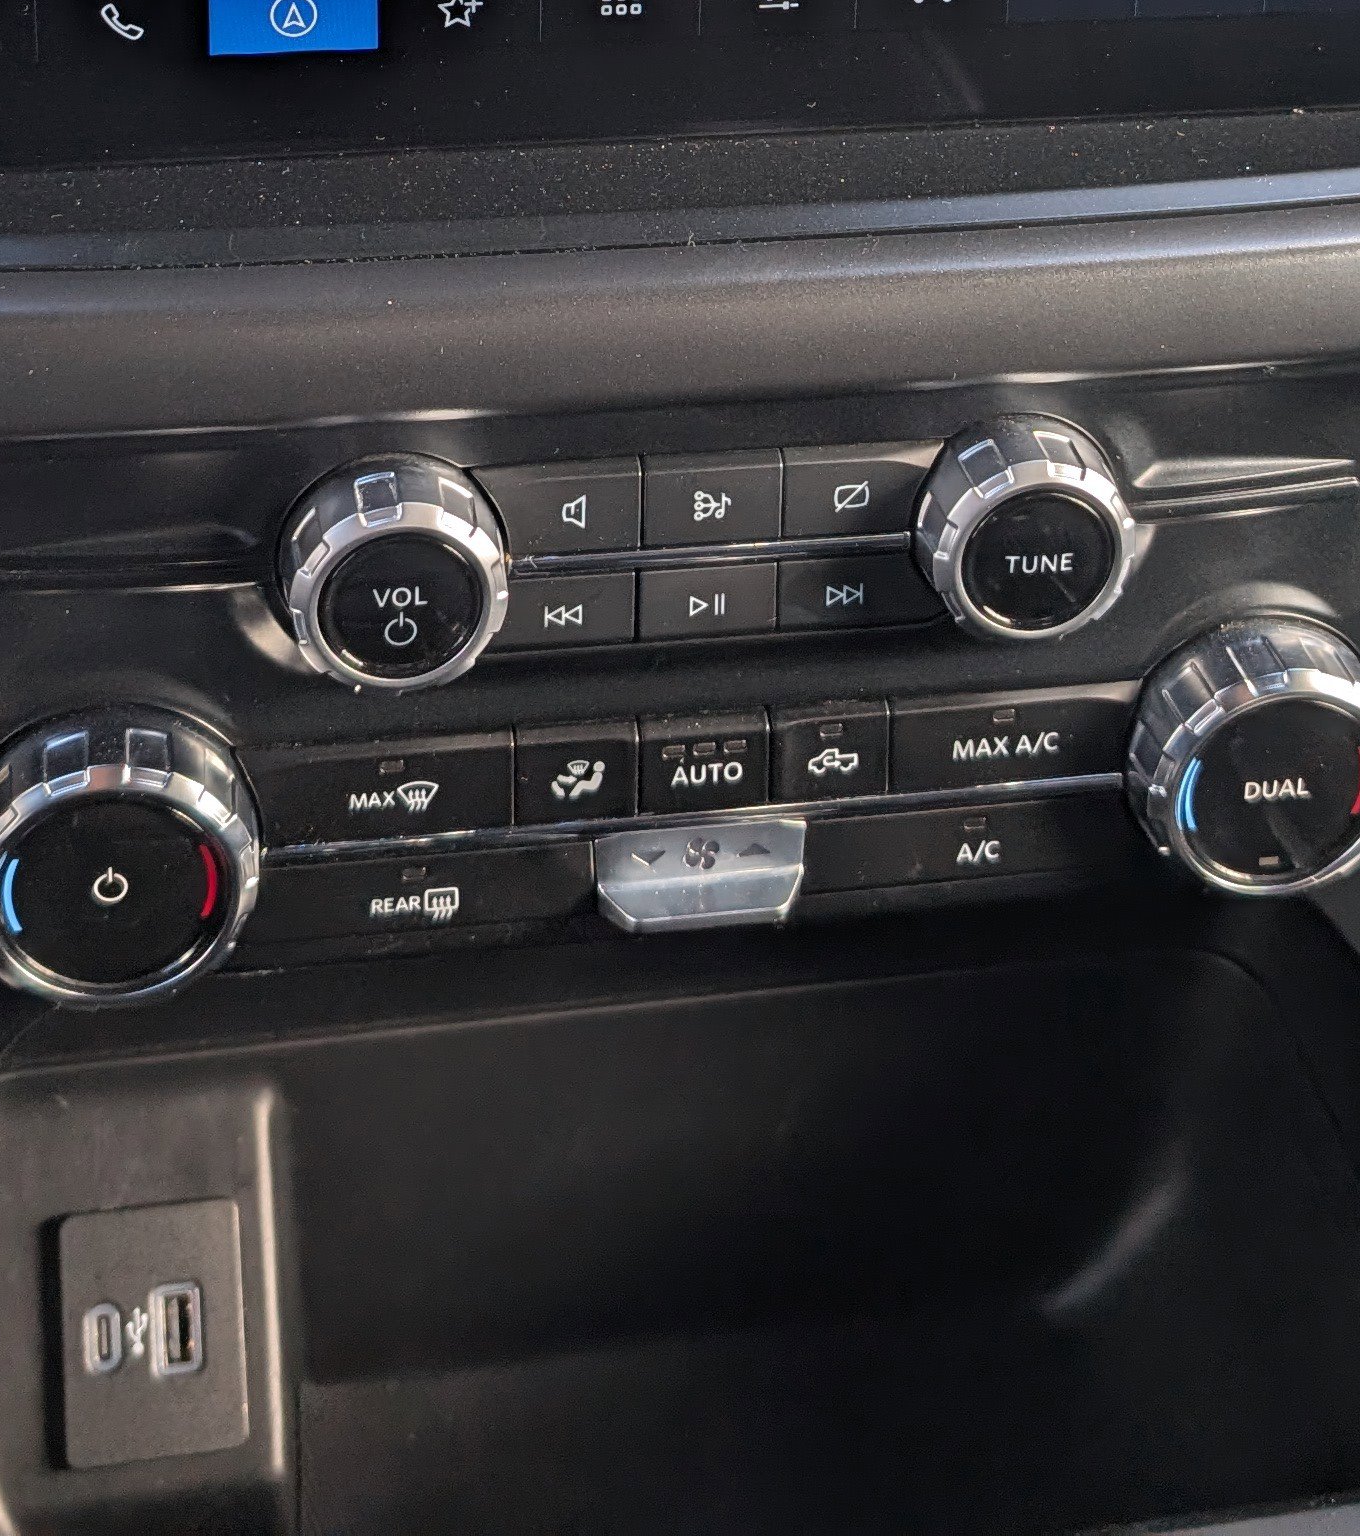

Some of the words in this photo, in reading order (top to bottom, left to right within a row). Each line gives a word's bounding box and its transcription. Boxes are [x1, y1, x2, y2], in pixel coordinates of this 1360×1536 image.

[1005, 552, 1075, 576] TUNE
[373, 587, 428, 610] VOL
[952, 734, 1009, 761] MAX
[1015, 731, 1060, 756] A/C
[670, 761, 743, 787] AUTO
[348, 790, 396, 811] MAX
[1243, 777, 1311, 803] DUAL
[956, 839, 1000, 864] A/C
[370, 895, 422, 916] REAR
